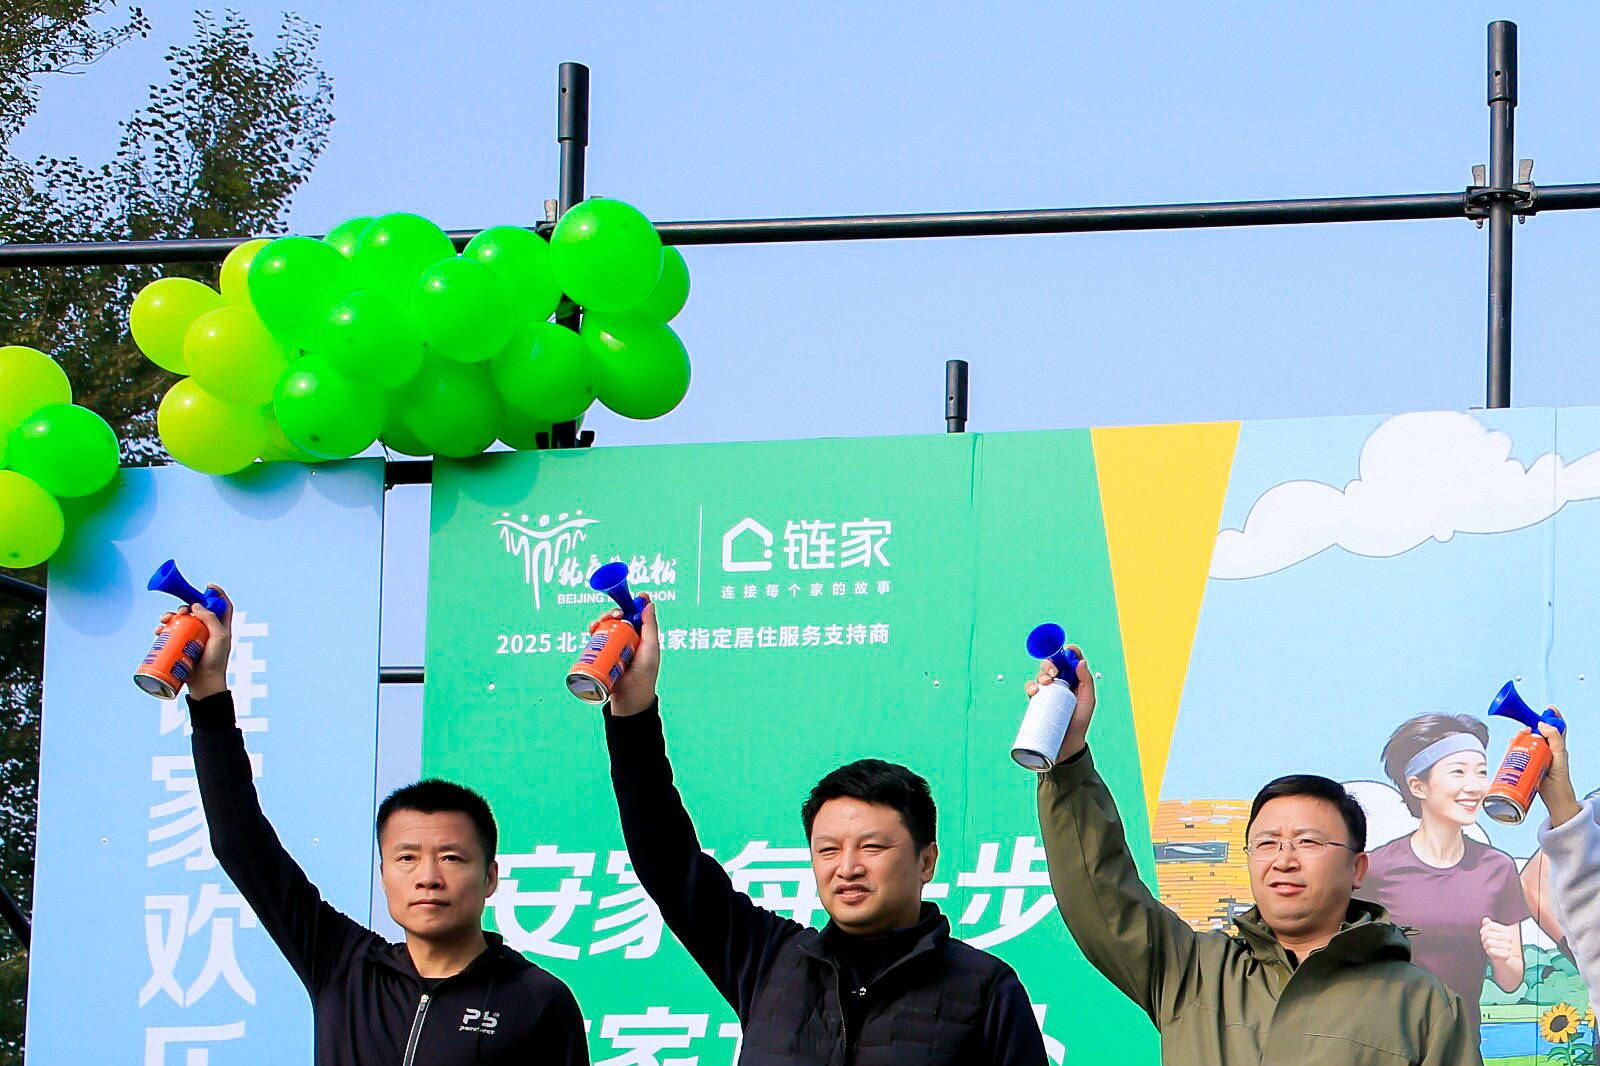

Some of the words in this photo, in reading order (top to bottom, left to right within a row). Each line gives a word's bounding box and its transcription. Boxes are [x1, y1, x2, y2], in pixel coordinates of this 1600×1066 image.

[783, 517, 892, 570] 链家
[557, 592, 605, 605] BEIJING
[721, 580, 891, 600] 连接每个家的故事
